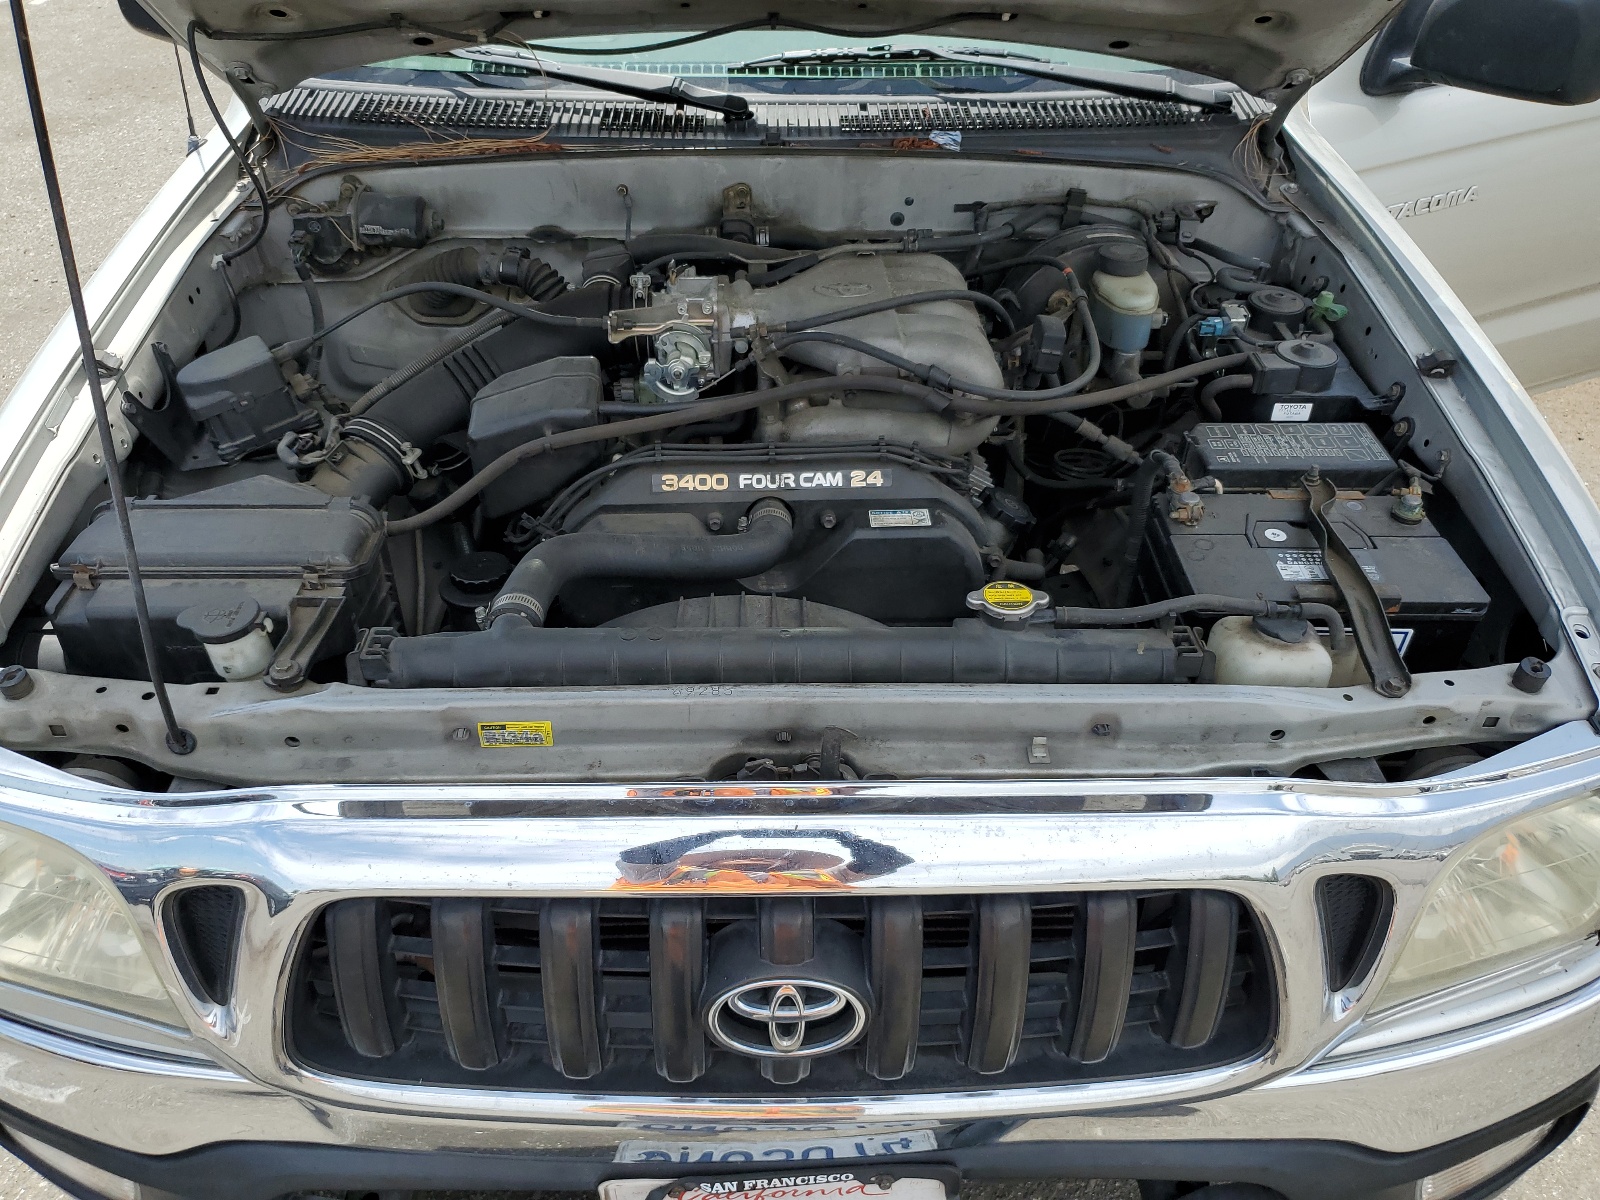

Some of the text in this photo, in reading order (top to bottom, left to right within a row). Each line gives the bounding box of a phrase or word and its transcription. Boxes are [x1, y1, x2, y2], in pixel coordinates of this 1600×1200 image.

[1385, 184, 1478, 219] TACOMA
[661, 470, 884, 491] 3400 FOUR CAM 24
[700, 1173, 854, 1194] SAN FRANCISCO
